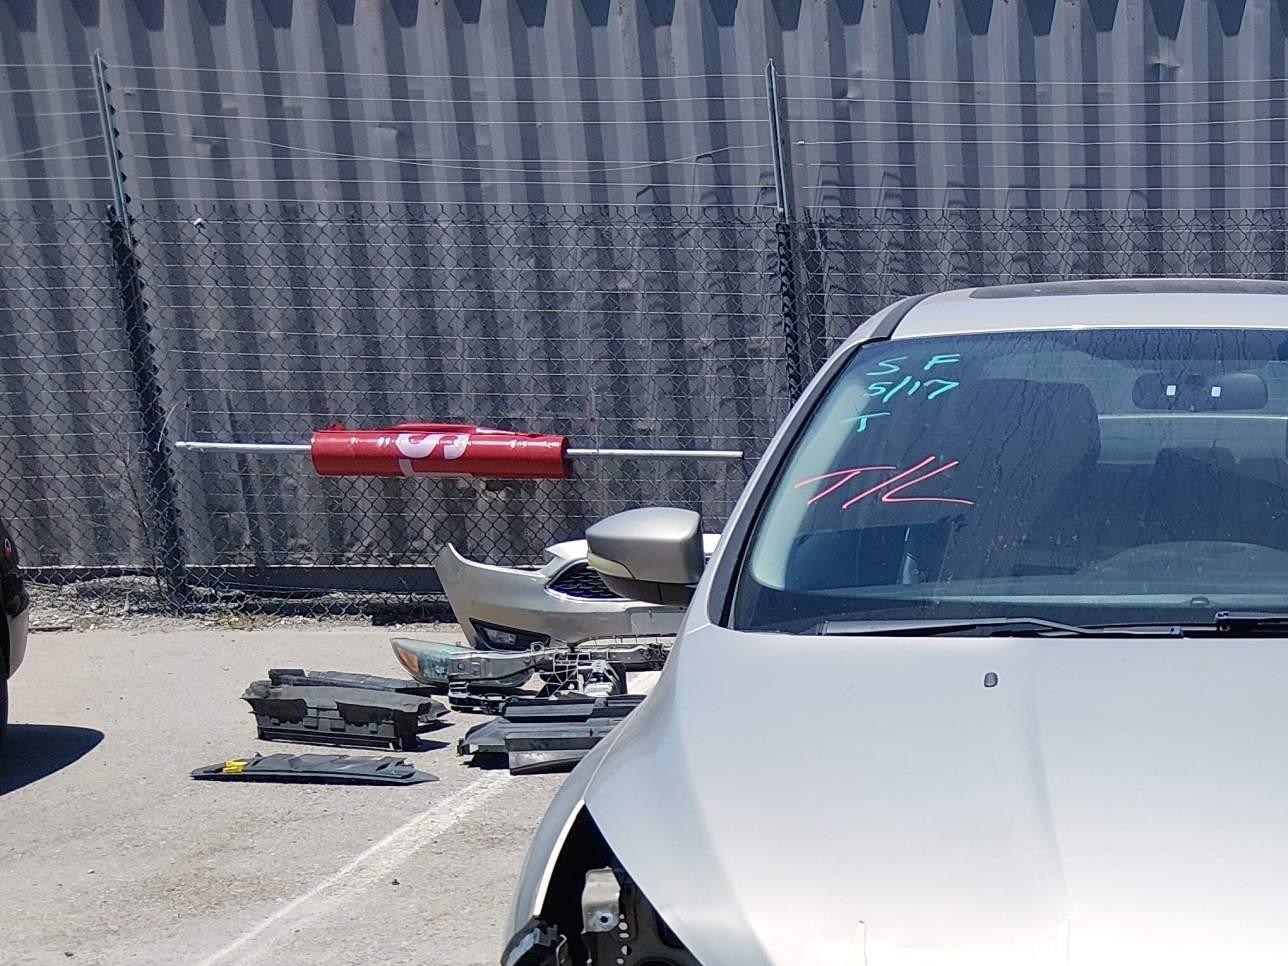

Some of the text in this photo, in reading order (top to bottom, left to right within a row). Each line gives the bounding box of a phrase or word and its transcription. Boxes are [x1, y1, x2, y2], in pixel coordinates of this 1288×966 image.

[866, 353, 961, 376] S F
[862, 375, 960, 403] 5/17
[840, 412, 891, 433] T
